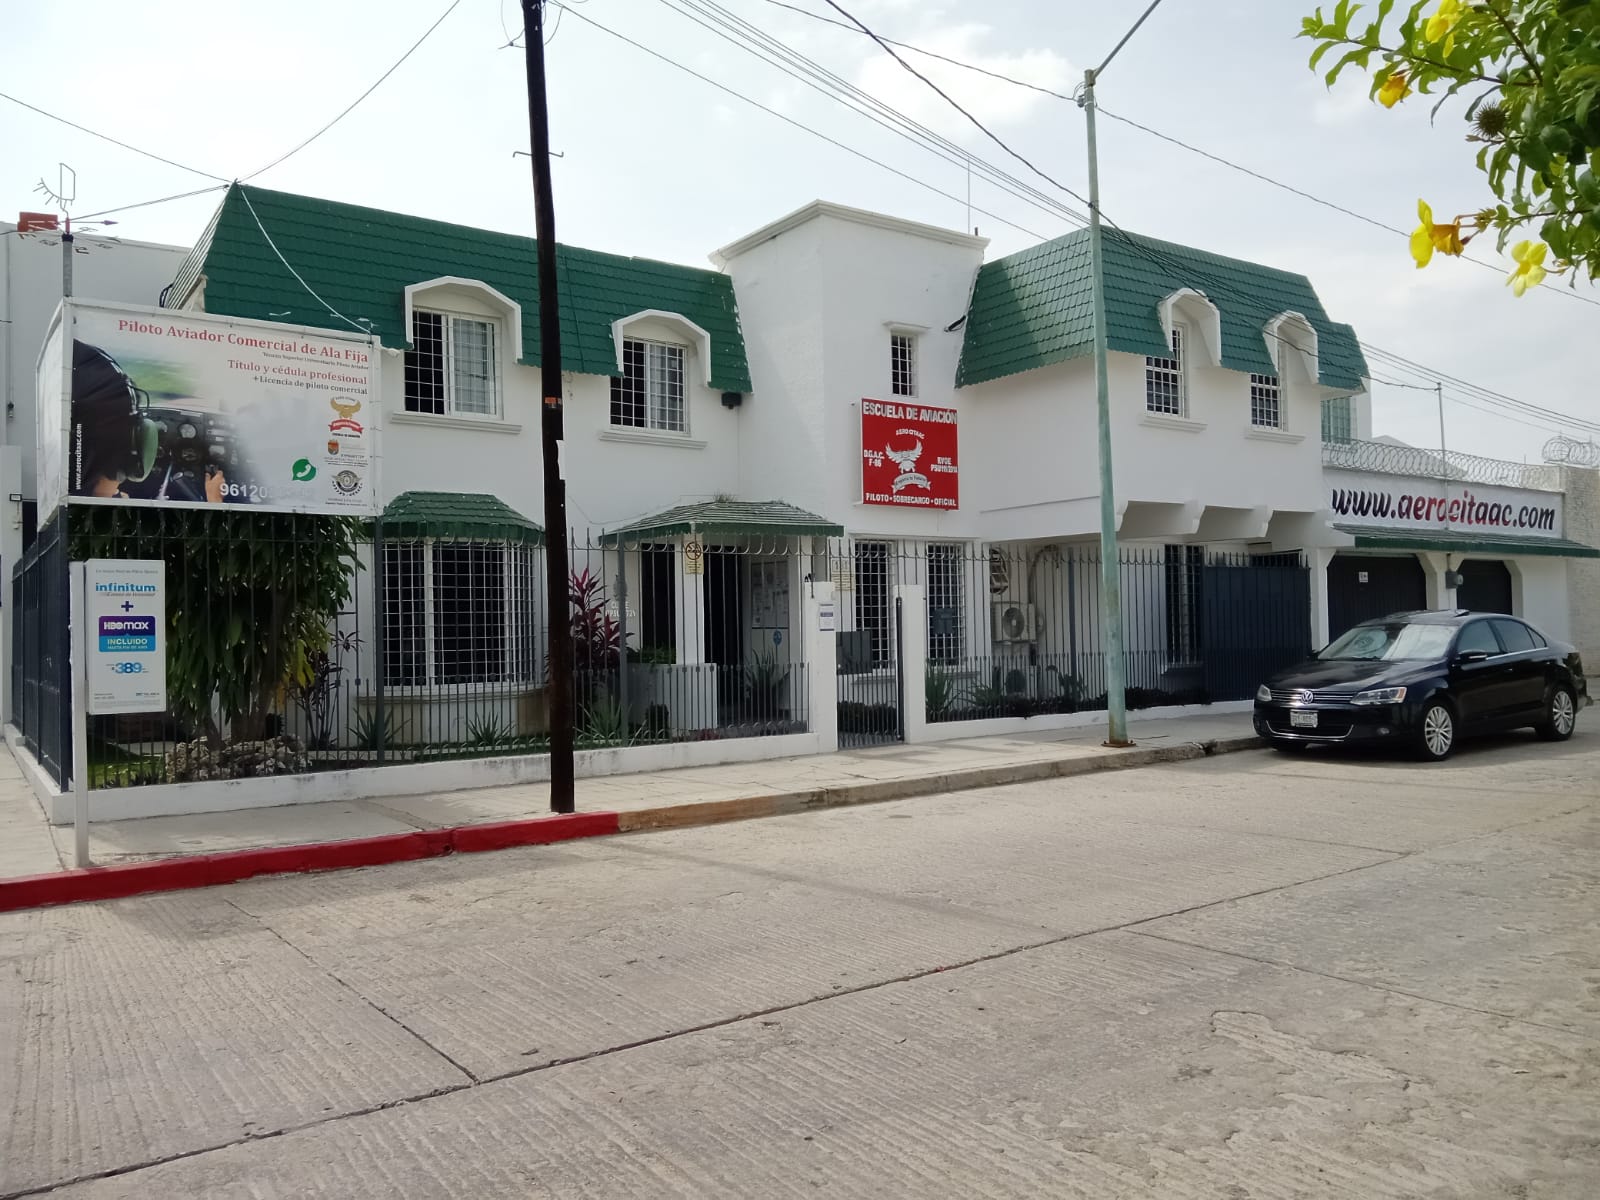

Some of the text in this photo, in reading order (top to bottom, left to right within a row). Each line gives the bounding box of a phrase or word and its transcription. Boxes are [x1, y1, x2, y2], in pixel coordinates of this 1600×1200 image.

[118, 319, 368, 364] Piloto Aviador Comercial de Ala Fija
[227, 359, 368, 385] Título y cédula profesional
[294, 379, 304, 388] de
[306, 381, 329, 390] piloto
[330, 384, 368, 395] comercial
[863, 401, 957, 425] ESCUELA DE AVIACIÓN
[865, 493, 957, 506] PILOTO SOBRECARGO OFICIAL
[1331, 489, 1556, 531] www.aerocitaac.com
[95, 582, 156, 592] infinitum
